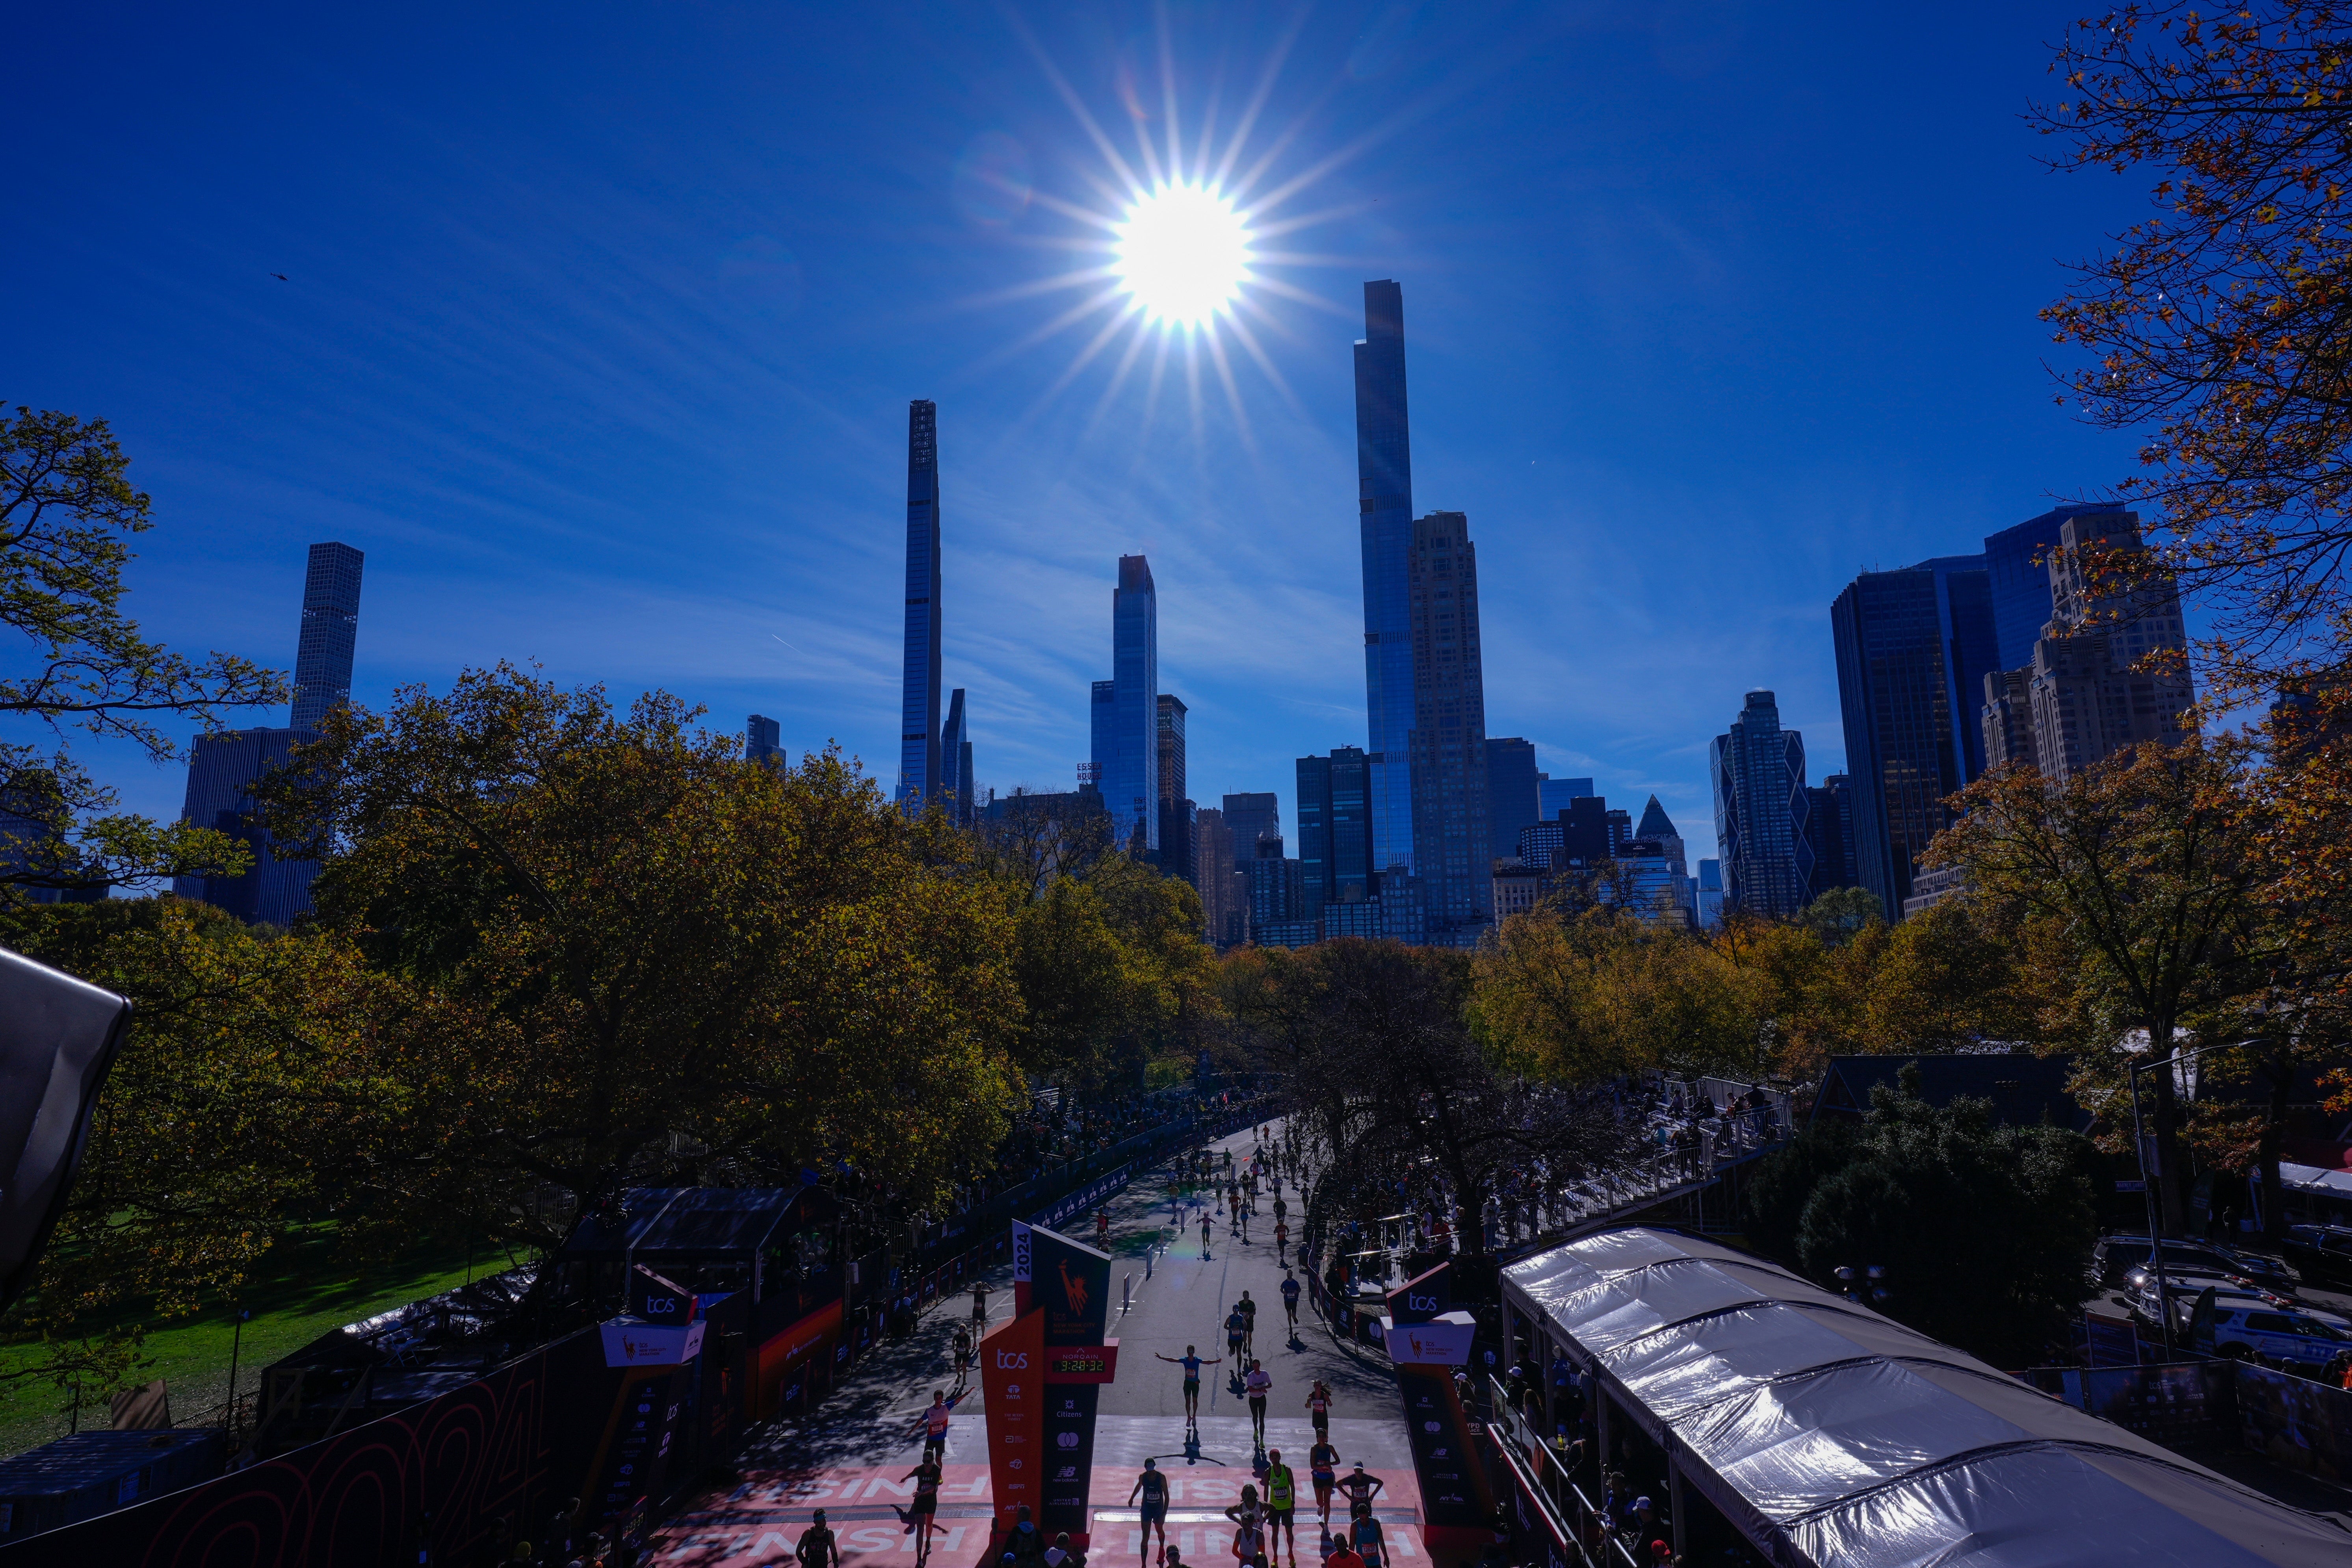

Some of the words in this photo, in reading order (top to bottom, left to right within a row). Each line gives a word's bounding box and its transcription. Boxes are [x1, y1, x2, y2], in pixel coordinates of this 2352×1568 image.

[1016, 1233, 1030, 1275] 2024
[647, 1295, 675, 1314] tcs
[1409, 1292, 1437, 1311] tcs
[997, 1349, 1028, 1369] tcs
[2305, 1345, 2336, 1358] NYP
[2148, 1381, 2161, 1390] tcs
[667, 1403, 678, 1421] tcs
[658, 1446, 668, 1457] TATA
[667, 1526, 966, 1561] FINSH
